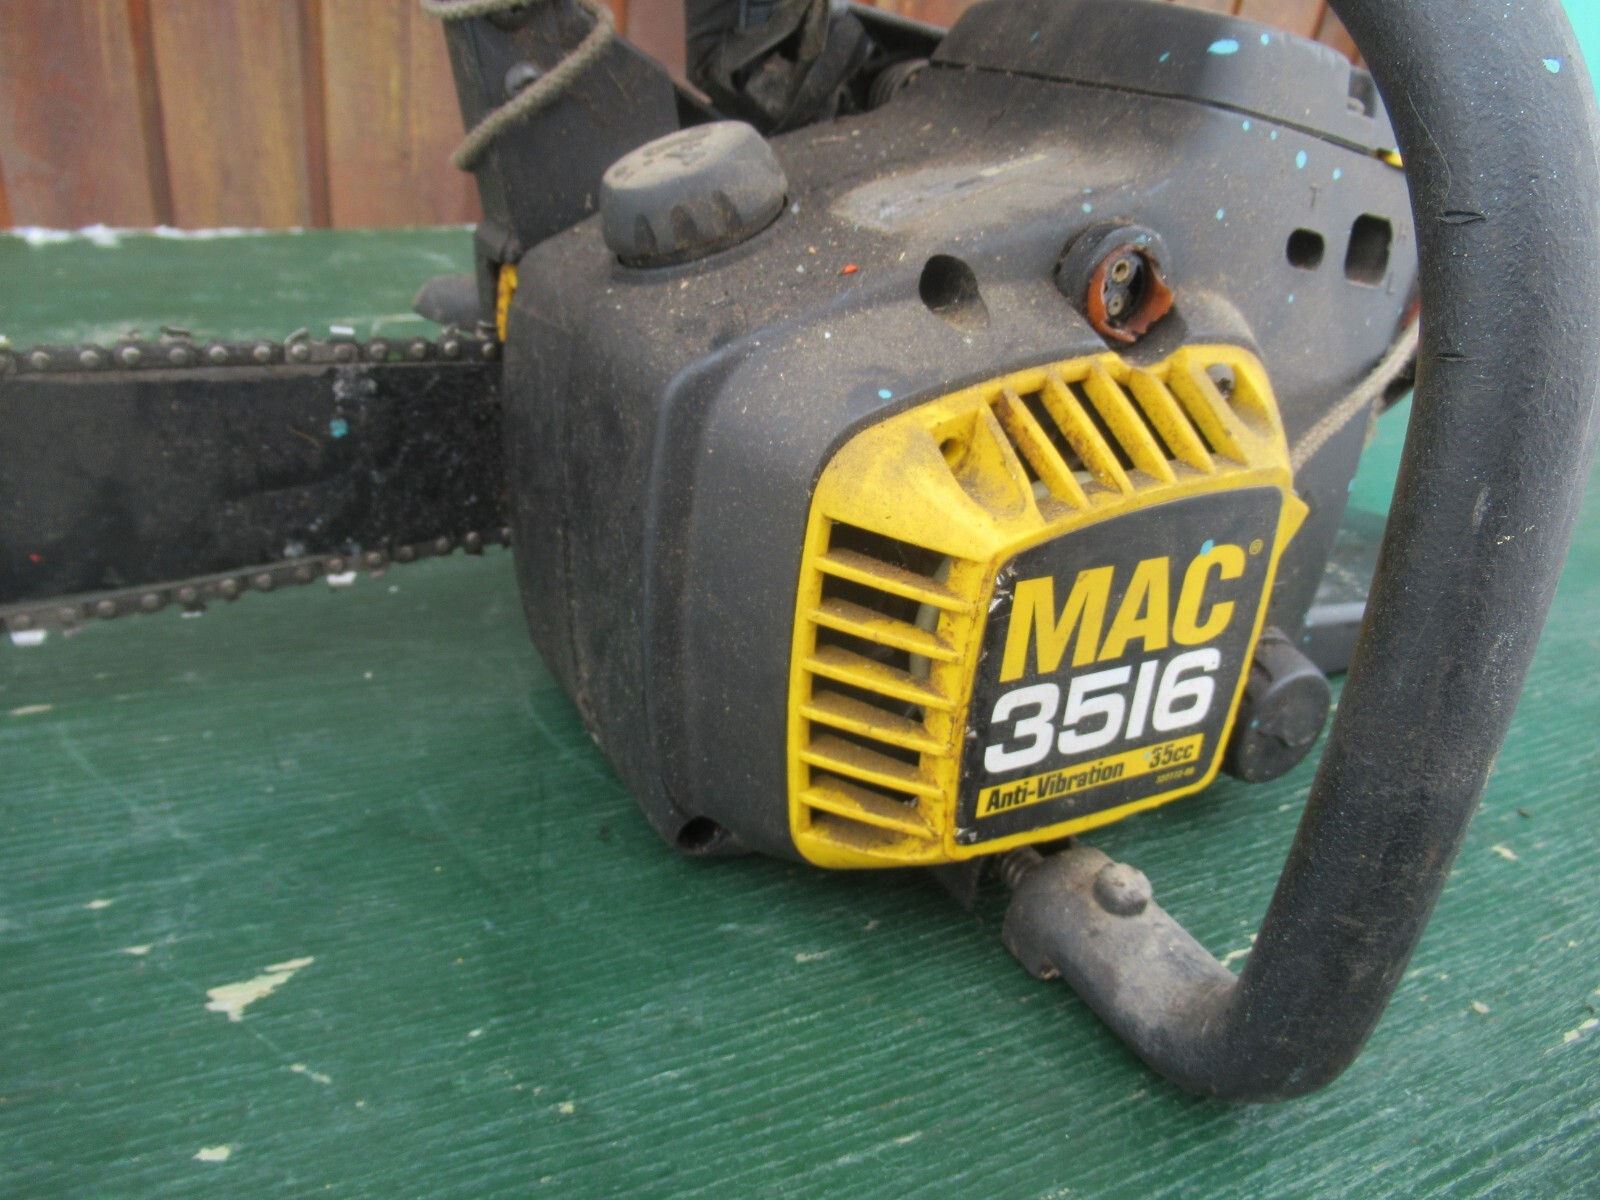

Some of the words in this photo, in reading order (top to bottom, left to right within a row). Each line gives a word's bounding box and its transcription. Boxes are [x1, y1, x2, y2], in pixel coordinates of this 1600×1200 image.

[999, 544, 1246, 683] MAC
[984, 648, 1221, 773] 3516
[985, 761, 1124, 812] Anti-Vibration
[1149, 743, 1194, 769] 35cc
